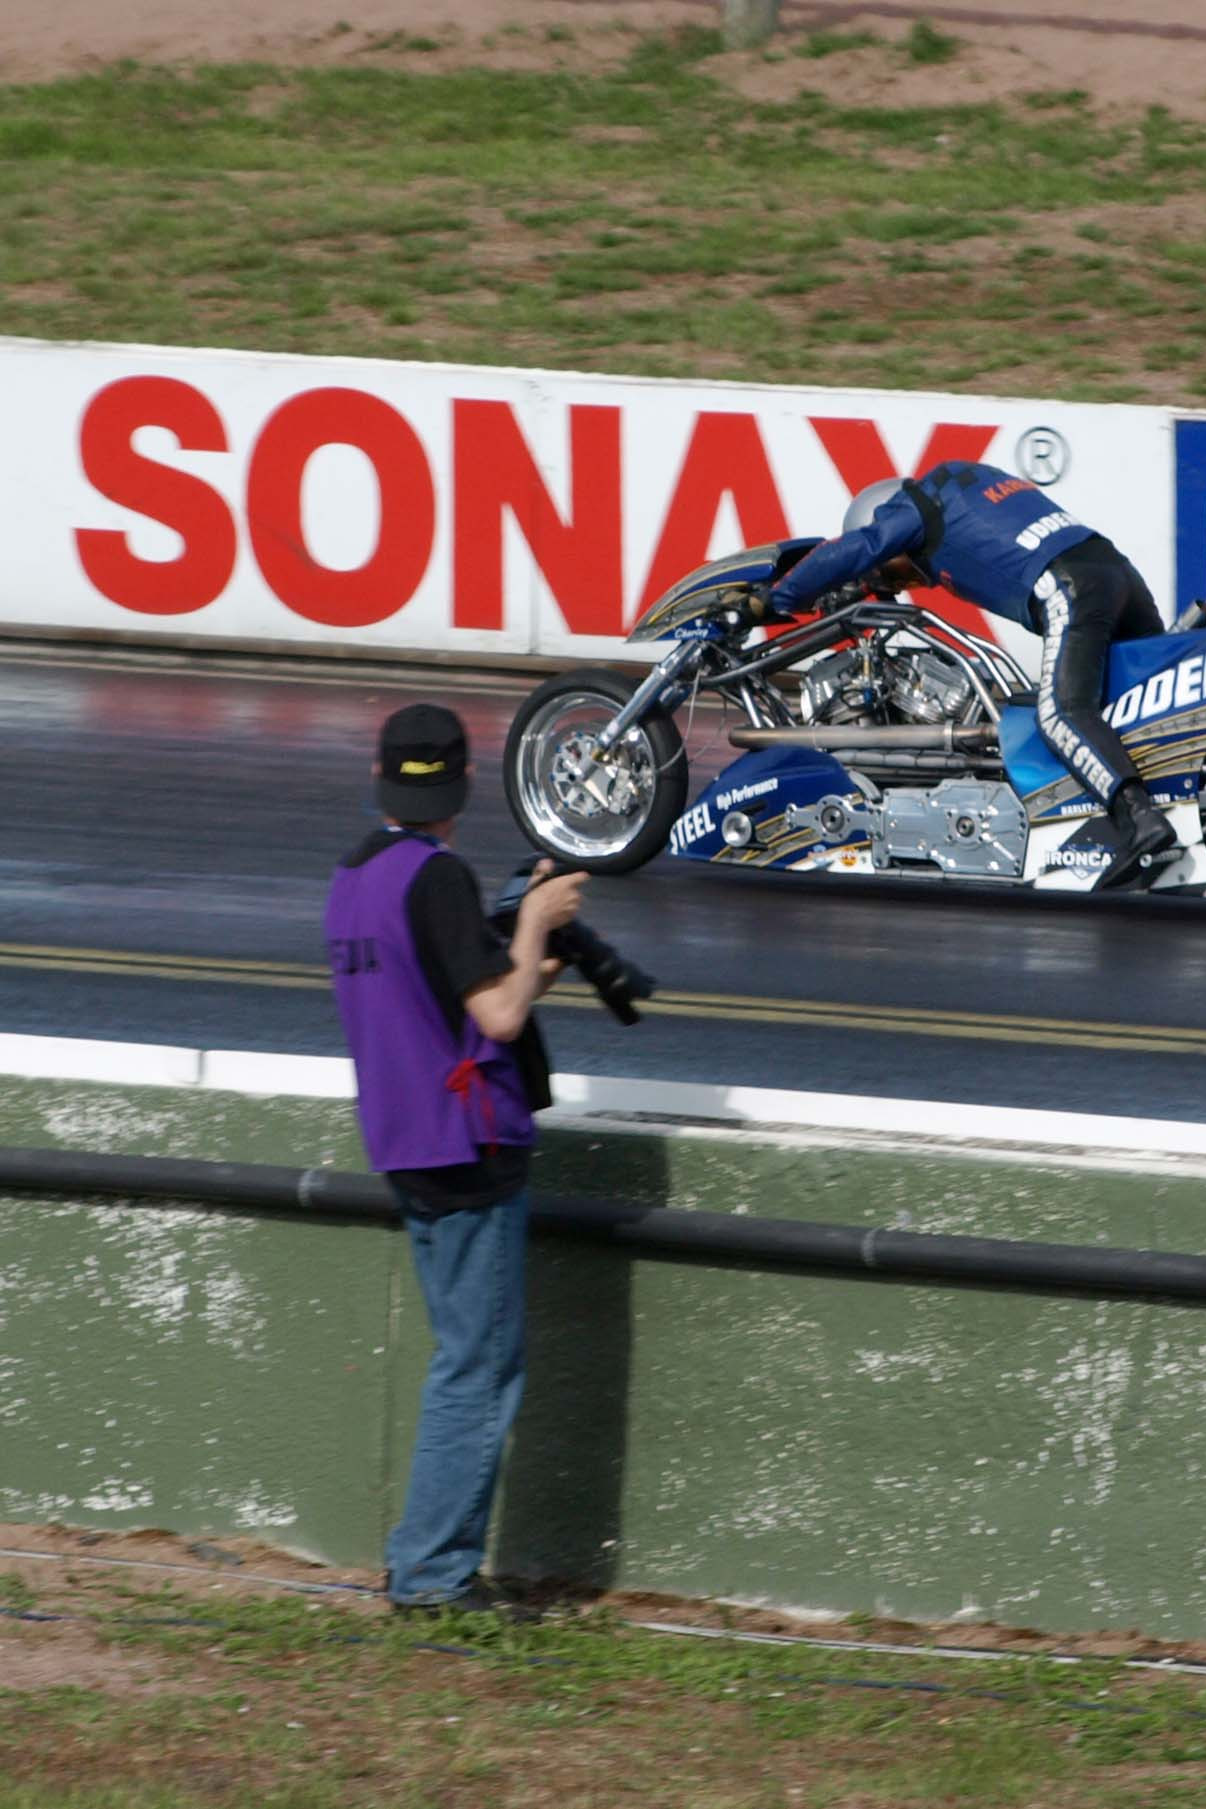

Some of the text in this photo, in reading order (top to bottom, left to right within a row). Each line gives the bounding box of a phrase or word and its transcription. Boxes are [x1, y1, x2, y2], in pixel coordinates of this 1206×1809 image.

[73, 374, 1002, 644] SONAX
[1072, 745, 1114, 800] STEEL
[670, 801, 716, 856] STEEL
